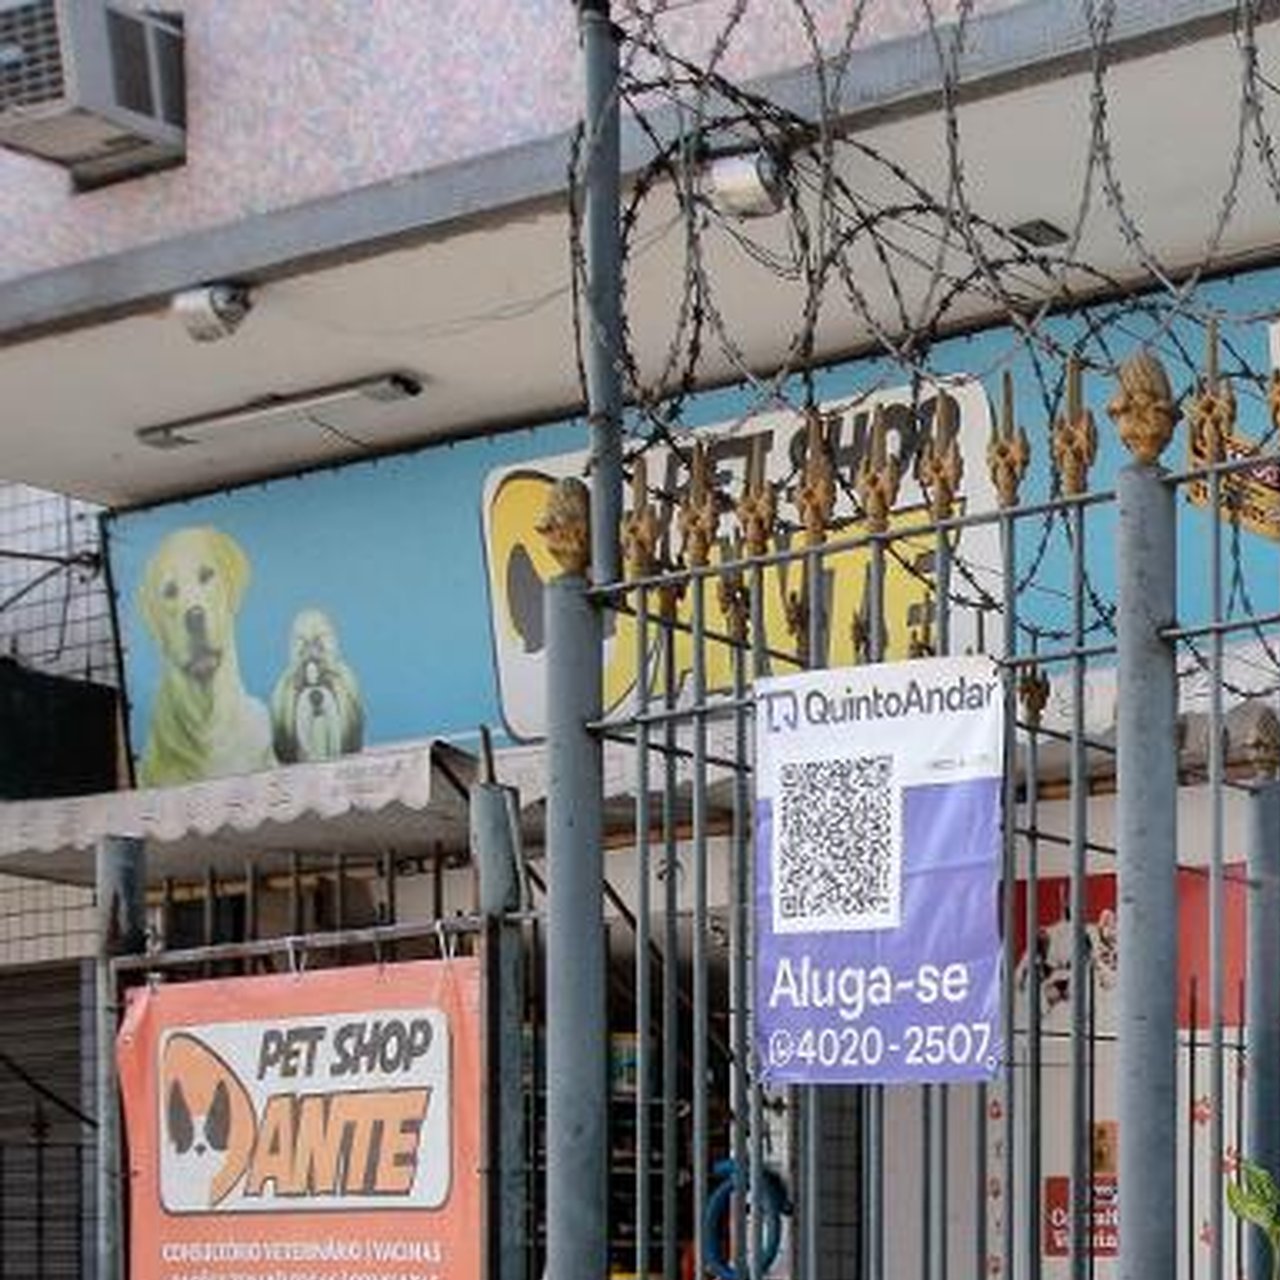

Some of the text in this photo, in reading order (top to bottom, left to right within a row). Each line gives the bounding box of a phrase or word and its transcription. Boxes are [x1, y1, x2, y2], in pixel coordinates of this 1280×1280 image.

[804, 676, 999, 729] QuintoAndar
[769, 957, 970, 1021] Aluga-se
[257, 1017, 435, 1081] PET SHOP
